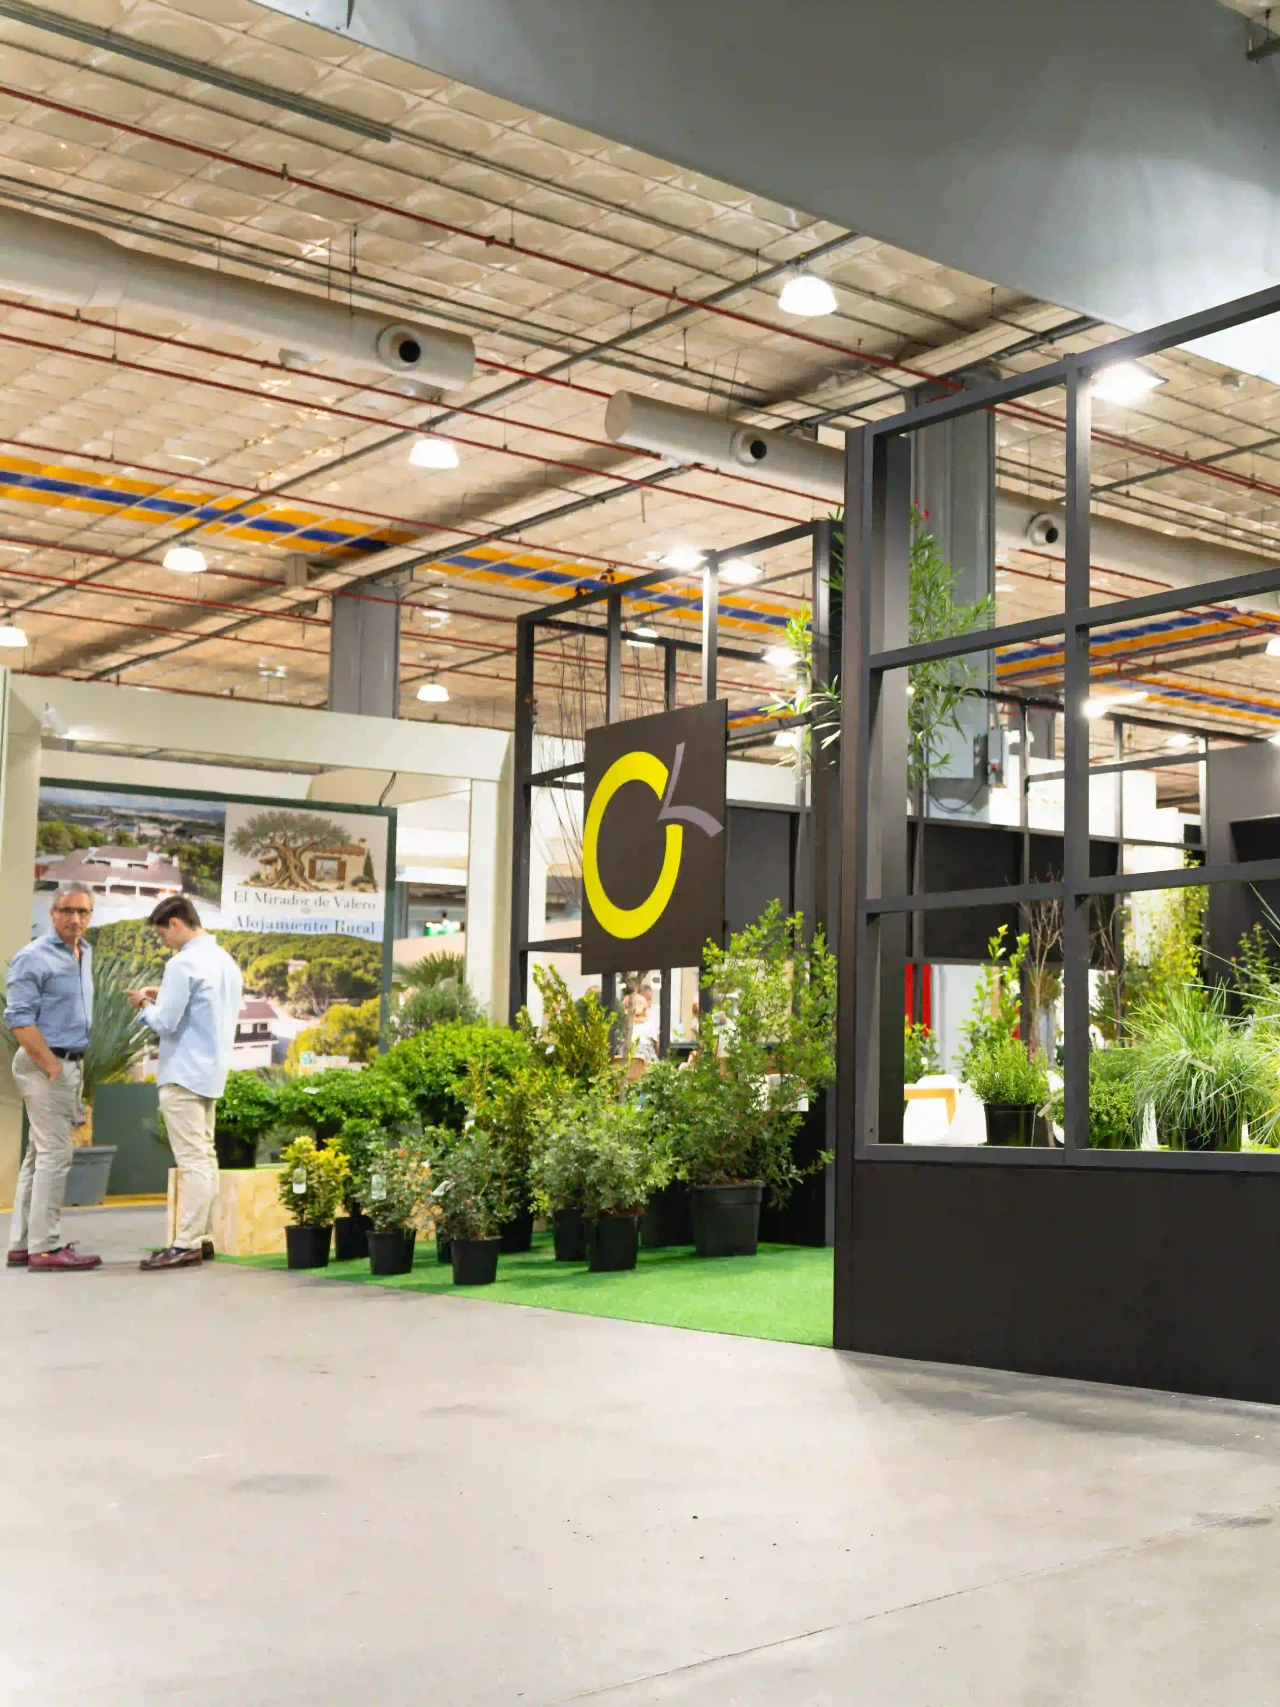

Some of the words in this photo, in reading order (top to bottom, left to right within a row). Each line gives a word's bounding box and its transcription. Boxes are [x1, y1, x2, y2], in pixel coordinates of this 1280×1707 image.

[234, 889, 247, 904] El
[254, 892, 309, 907] Mirador
[314, 896, 330, 908] de
[332, 896, 376, 910] Valero
[235, 915, 328, 933] Alojamiento
[334, 919, 375, 935] Rural
